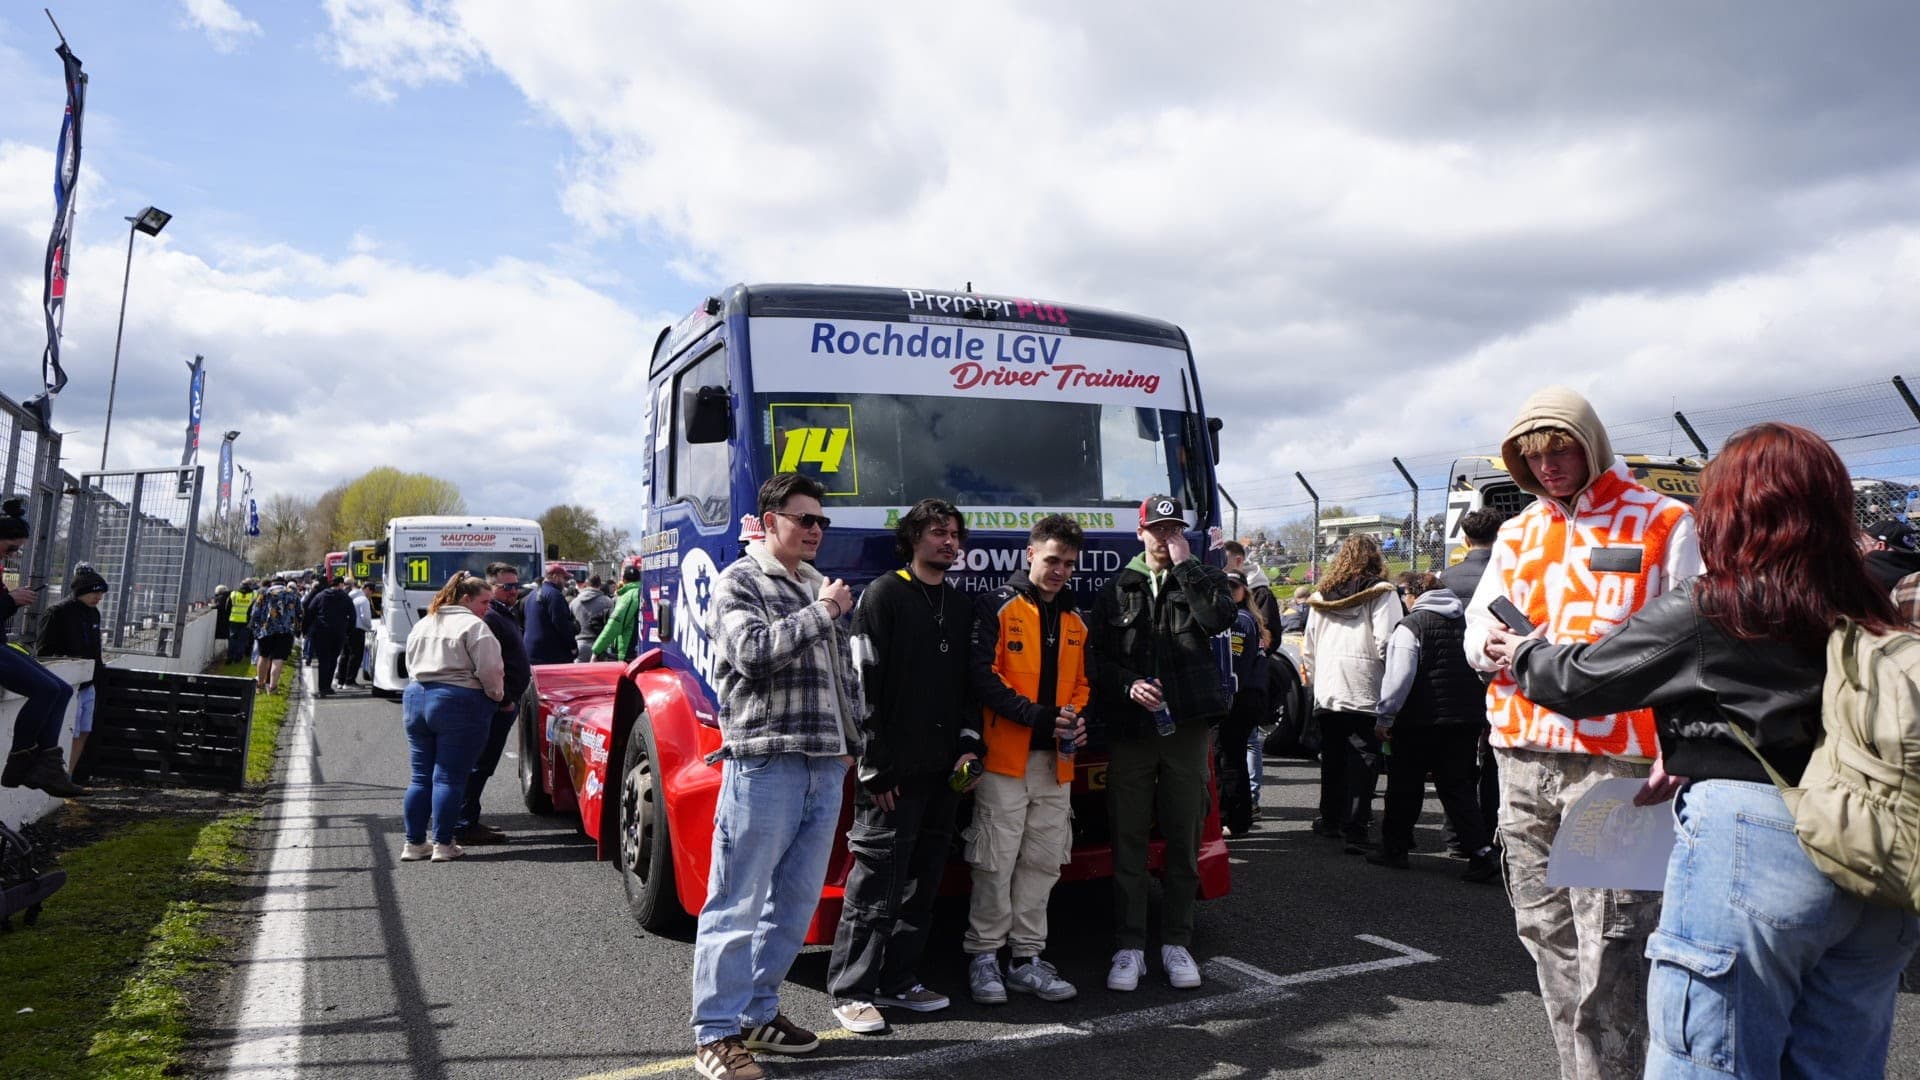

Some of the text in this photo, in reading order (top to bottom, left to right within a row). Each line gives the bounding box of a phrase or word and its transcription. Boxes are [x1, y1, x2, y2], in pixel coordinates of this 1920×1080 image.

[902, 289, 1012, 317] Premier
[1015, 298, 1069, 325] Pits
[811, 322, 984, 360] Rochdale
[996, 333, 1061, 365] LGV
[949, 362, 1160, 394] Driver Training
[778, 427, 849, 473] 14
[446, 534, 496, 542] AUTOQUIP
[358, 564, 367, 576] 12
[409, 560, 428, 582] 11
[1079, 550, 1121, 571] LTD
